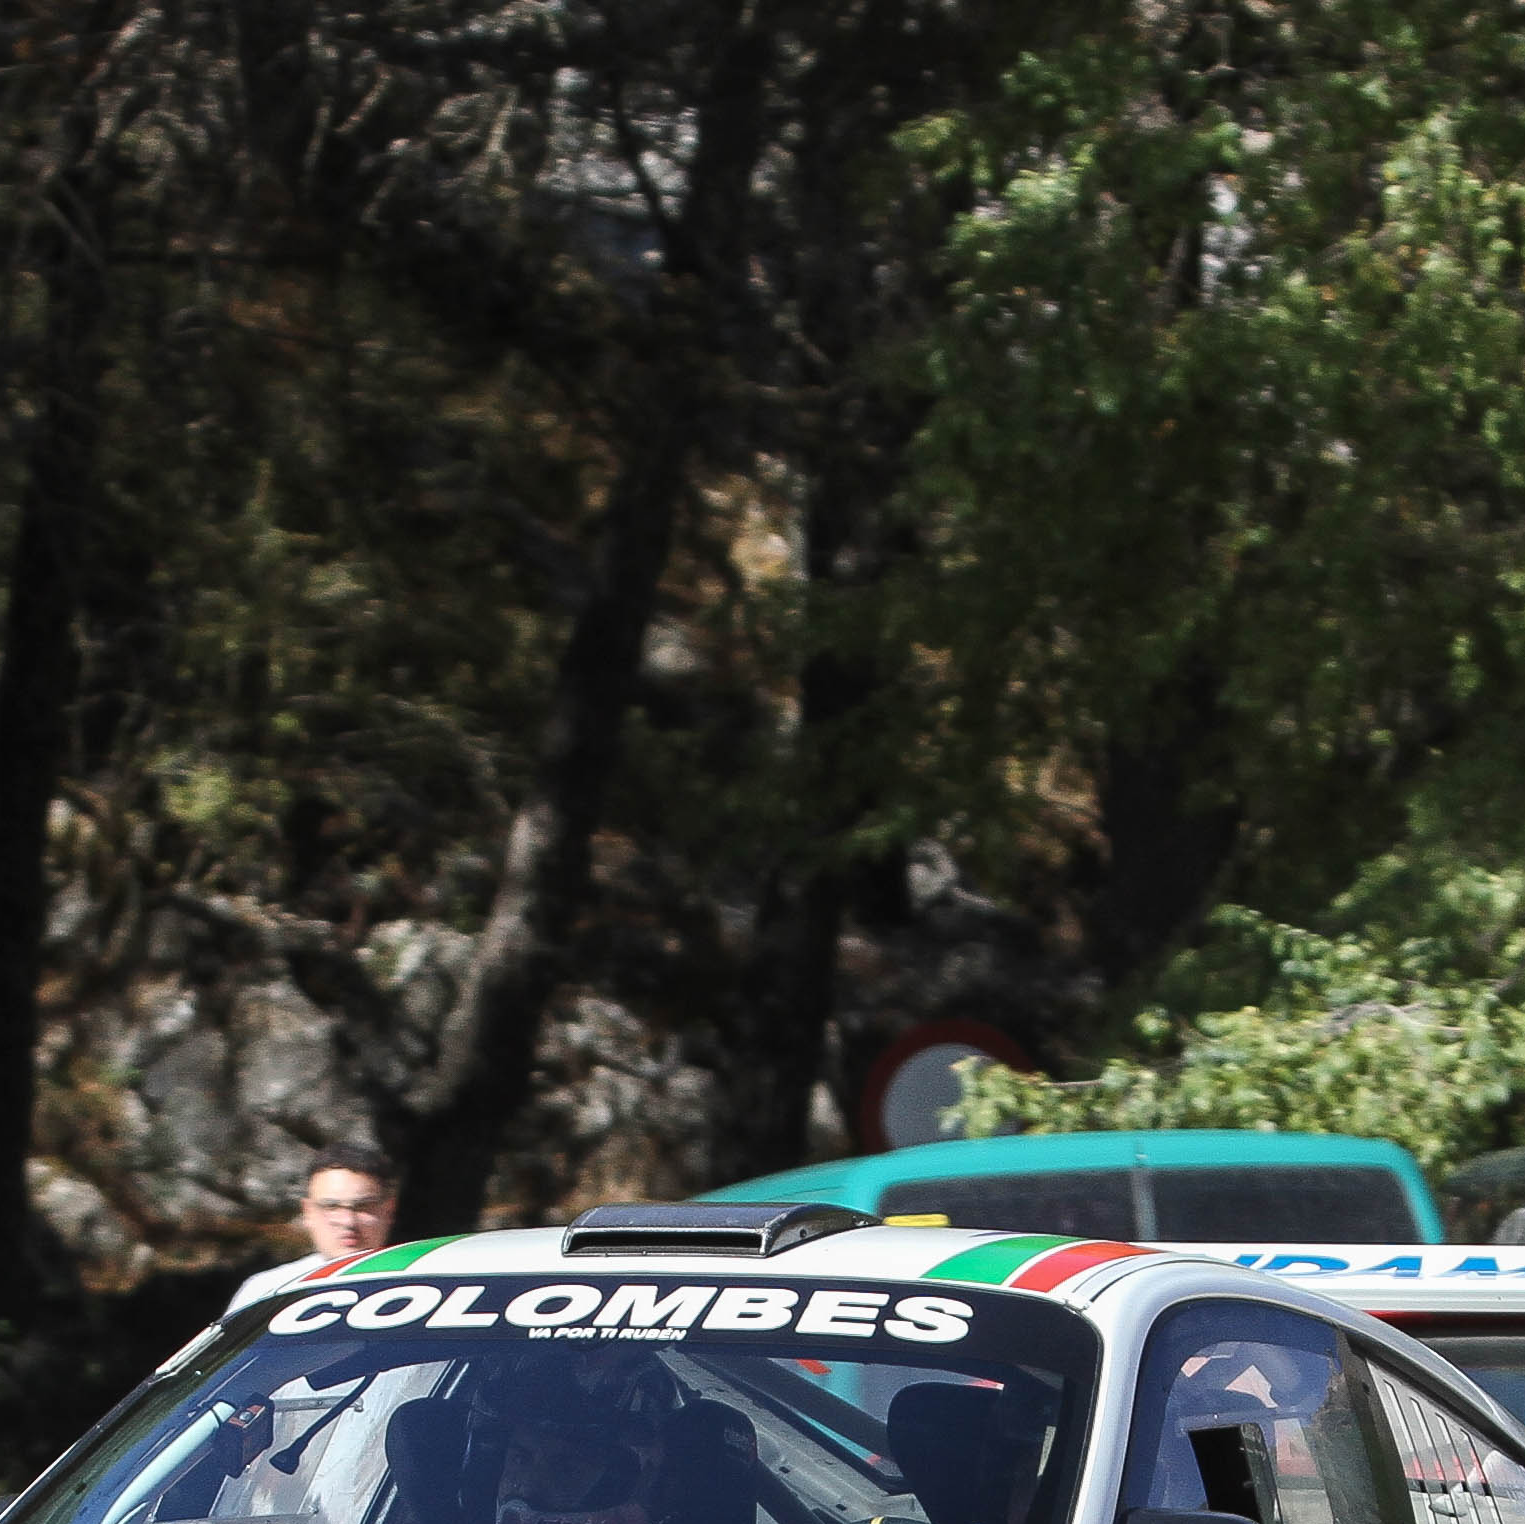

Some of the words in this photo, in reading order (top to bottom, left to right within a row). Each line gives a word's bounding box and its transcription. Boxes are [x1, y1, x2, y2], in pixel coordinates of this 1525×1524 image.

[267, 1285, 974, 1343] COLOMBES
[529, 1327, 551, 1338] VA
[554, 1327, 596, 1338] POR
[600, 1328, 618, 1338] TI
[619, 1327, 687, 1340] RUBÉN
